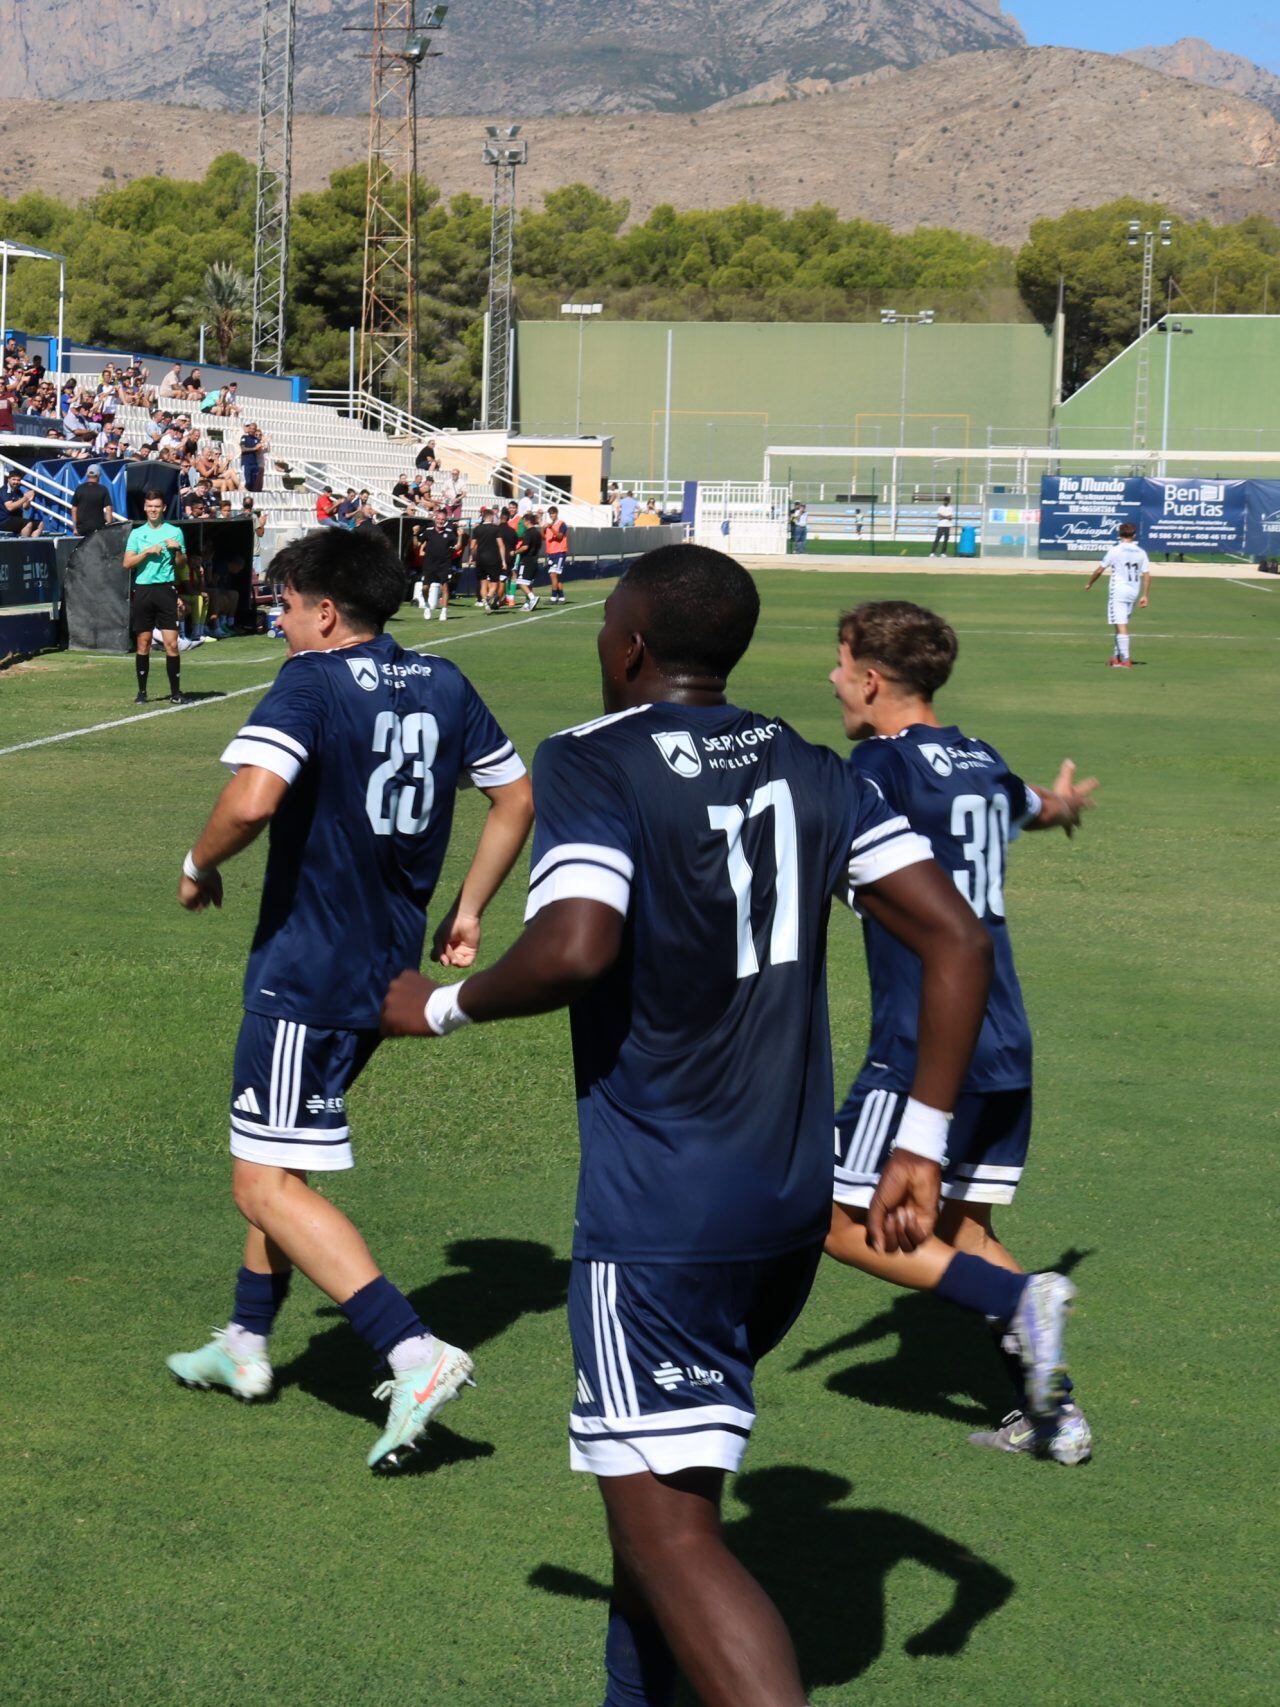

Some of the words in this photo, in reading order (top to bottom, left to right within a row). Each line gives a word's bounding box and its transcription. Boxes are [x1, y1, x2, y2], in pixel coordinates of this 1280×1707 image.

[1081, 477, 1125, 492] Mundo
[1163, 501, 1223, 517] Puertas
[1125, 562, 1139, 582] 11
[709, 752, 759, 770] HOELES
